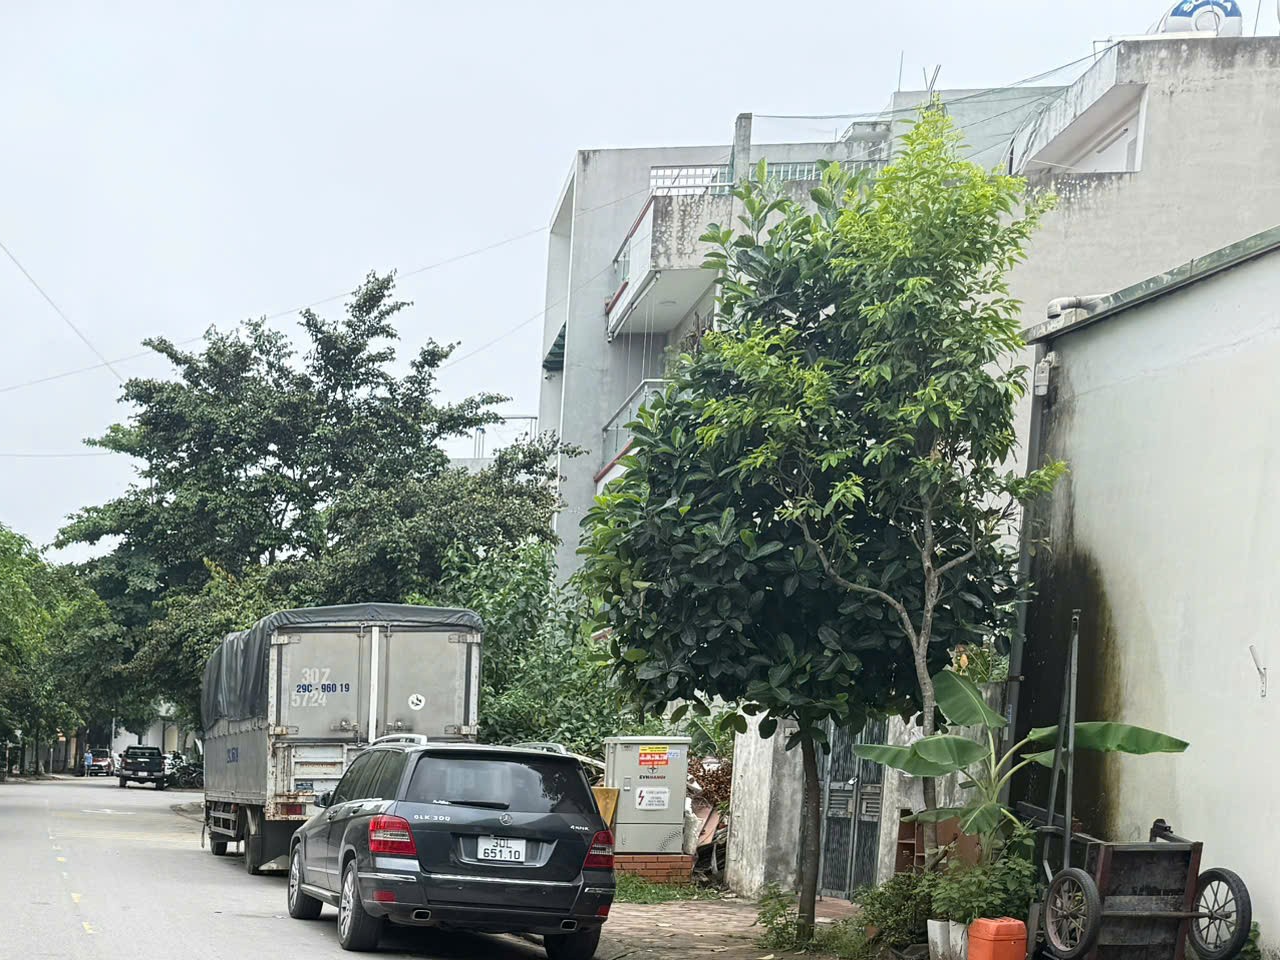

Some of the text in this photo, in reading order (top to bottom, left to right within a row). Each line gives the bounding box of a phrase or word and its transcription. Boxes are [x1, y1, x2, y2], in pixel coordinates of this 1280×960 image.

[296, 684, 313, 693] 29C
[321, 683, 337, 693] 960
[339, 683, 350, 693] 19
[291, 691, 327, 707] 5724
[492, 838, 512, 849] 30L
[483, 849, 521, 860] 651.10
